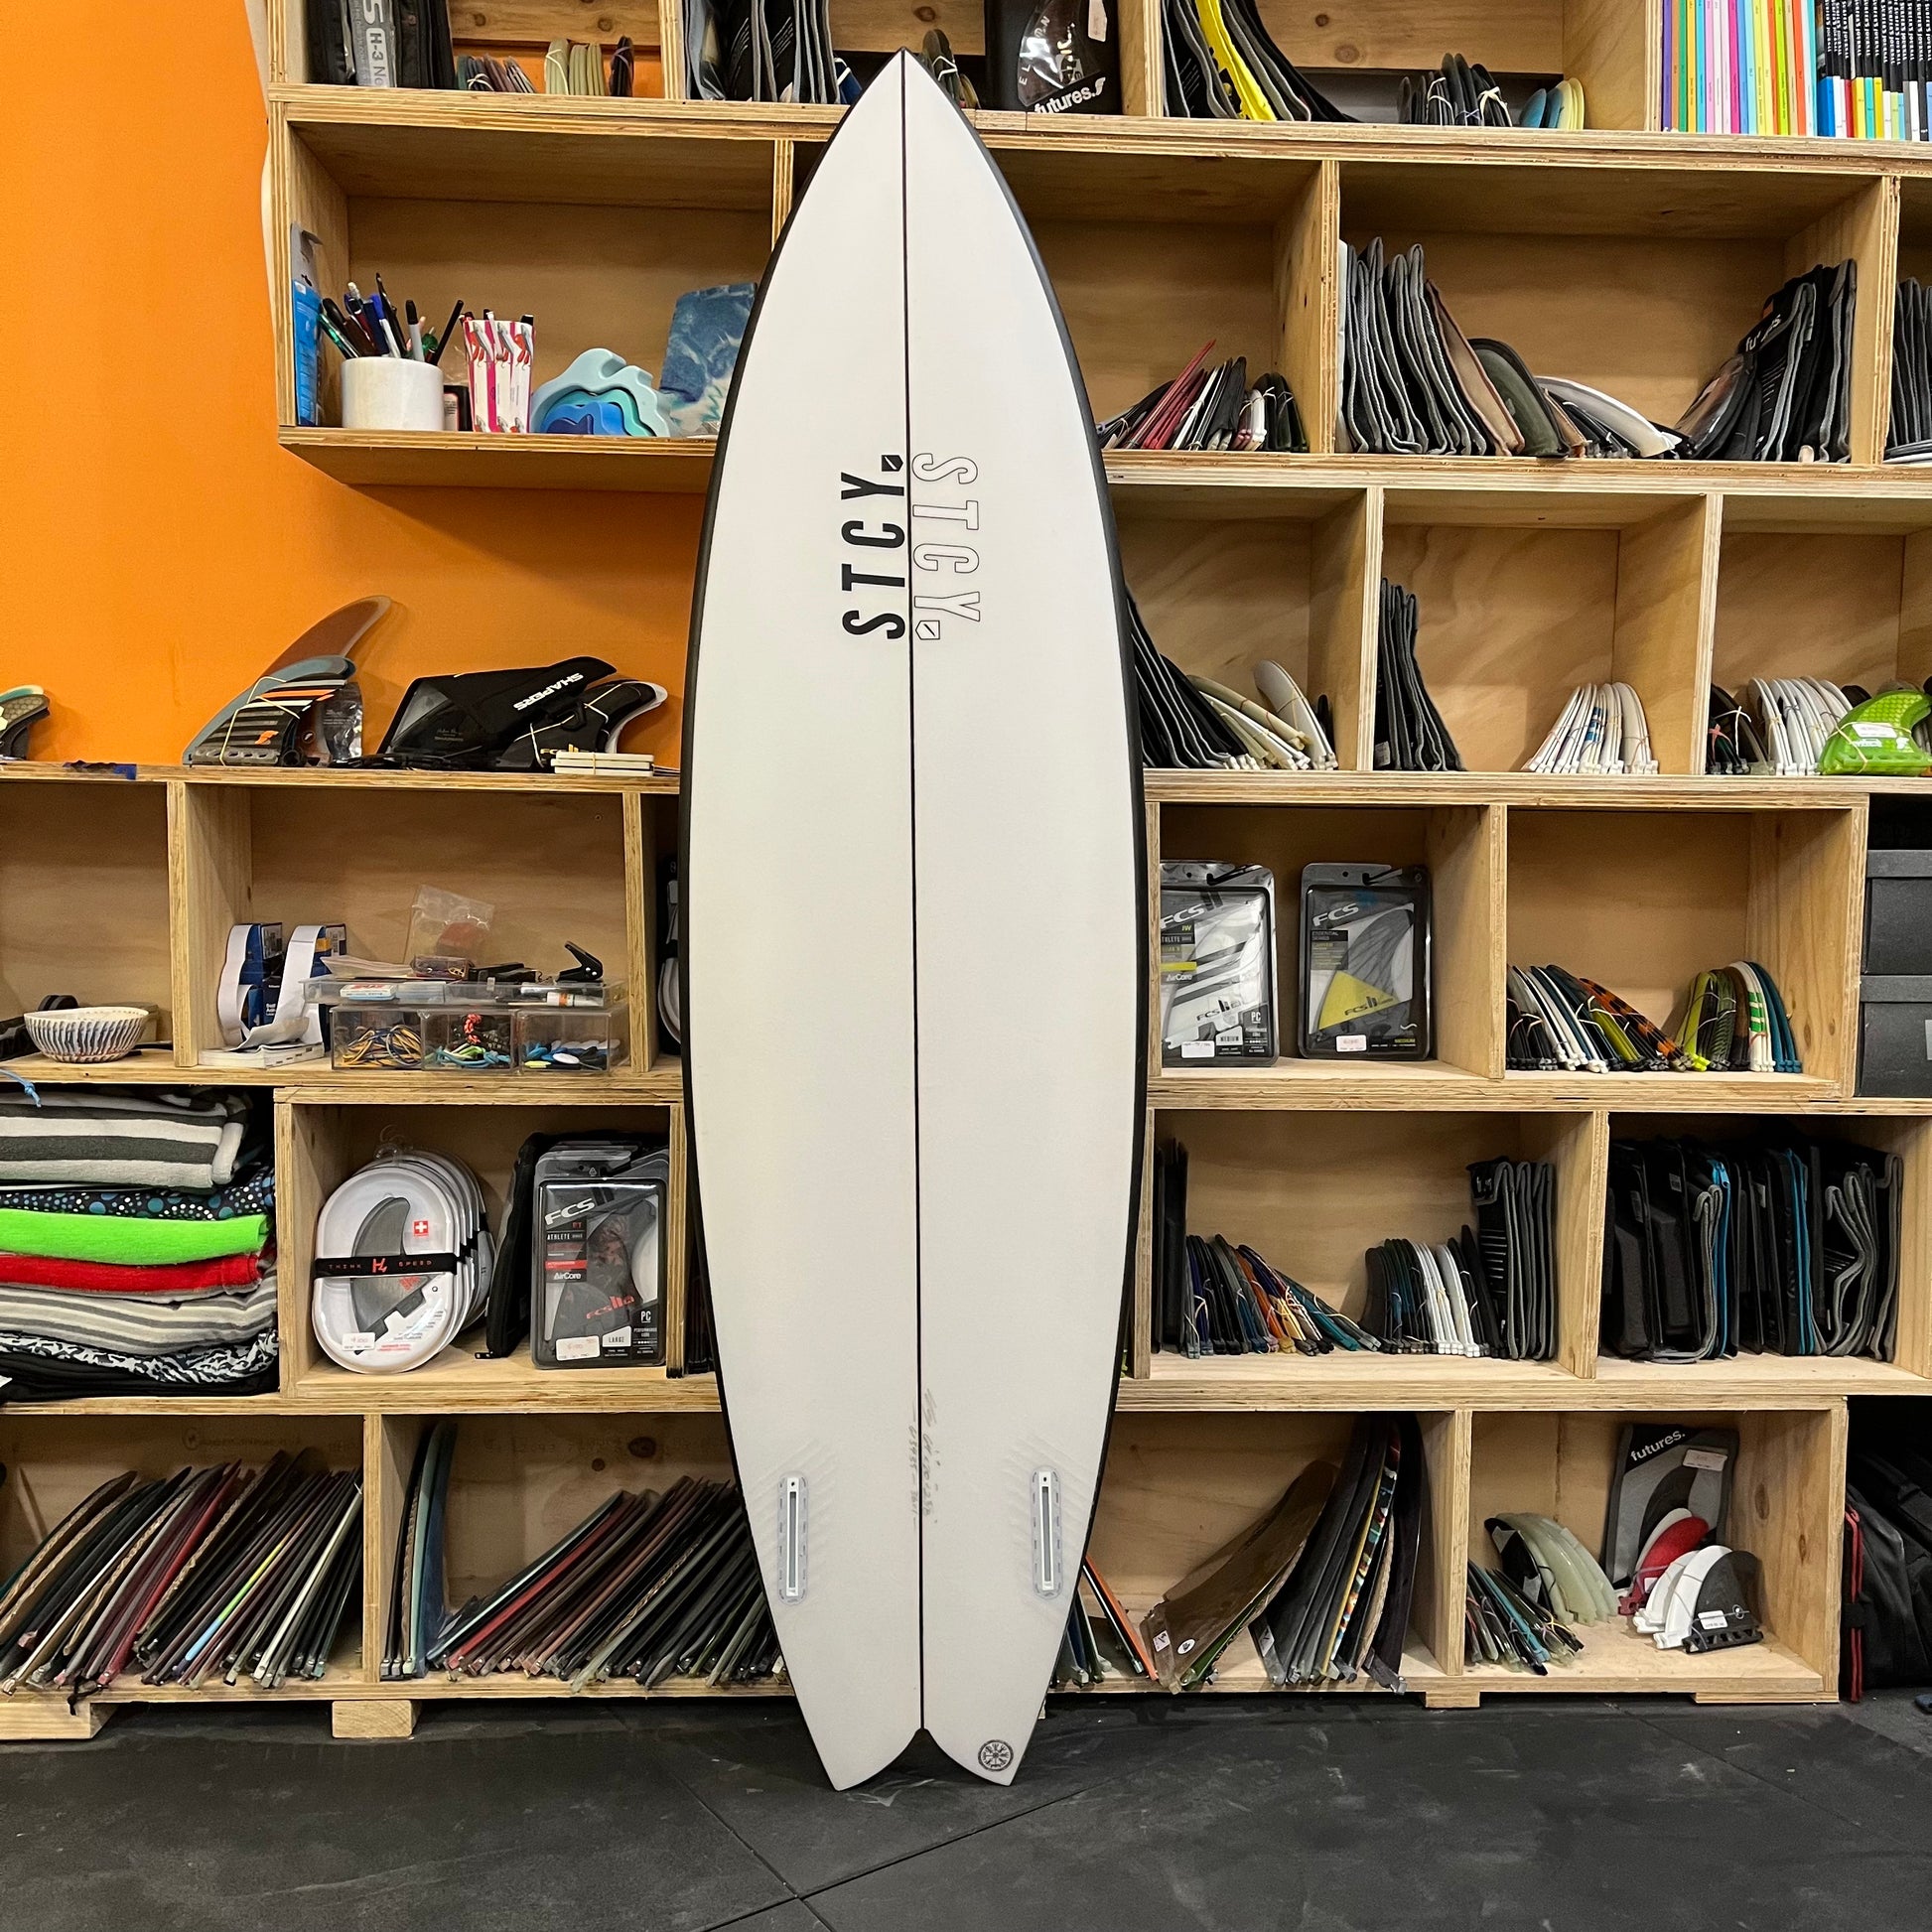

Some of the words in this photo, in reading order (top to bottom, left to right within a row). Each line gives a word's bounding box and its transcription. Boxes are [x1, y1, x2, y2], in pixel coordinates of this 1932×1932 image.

[369, 33, 384, 61] H-3
[513, 672, 584, 711] SHAPERS
[1161, 903, 1205, 929] FCS
[1312, 902, 1359, 927] FCS
[1251, 1012, 1261, 1022] PC
[545, 1197, 595, 1225] FCS
[554, 1272, 582, 1281] AirCore
[640, 1311, 651, 1321] PC
[1630, 1430, 1686, 1461] futures.
